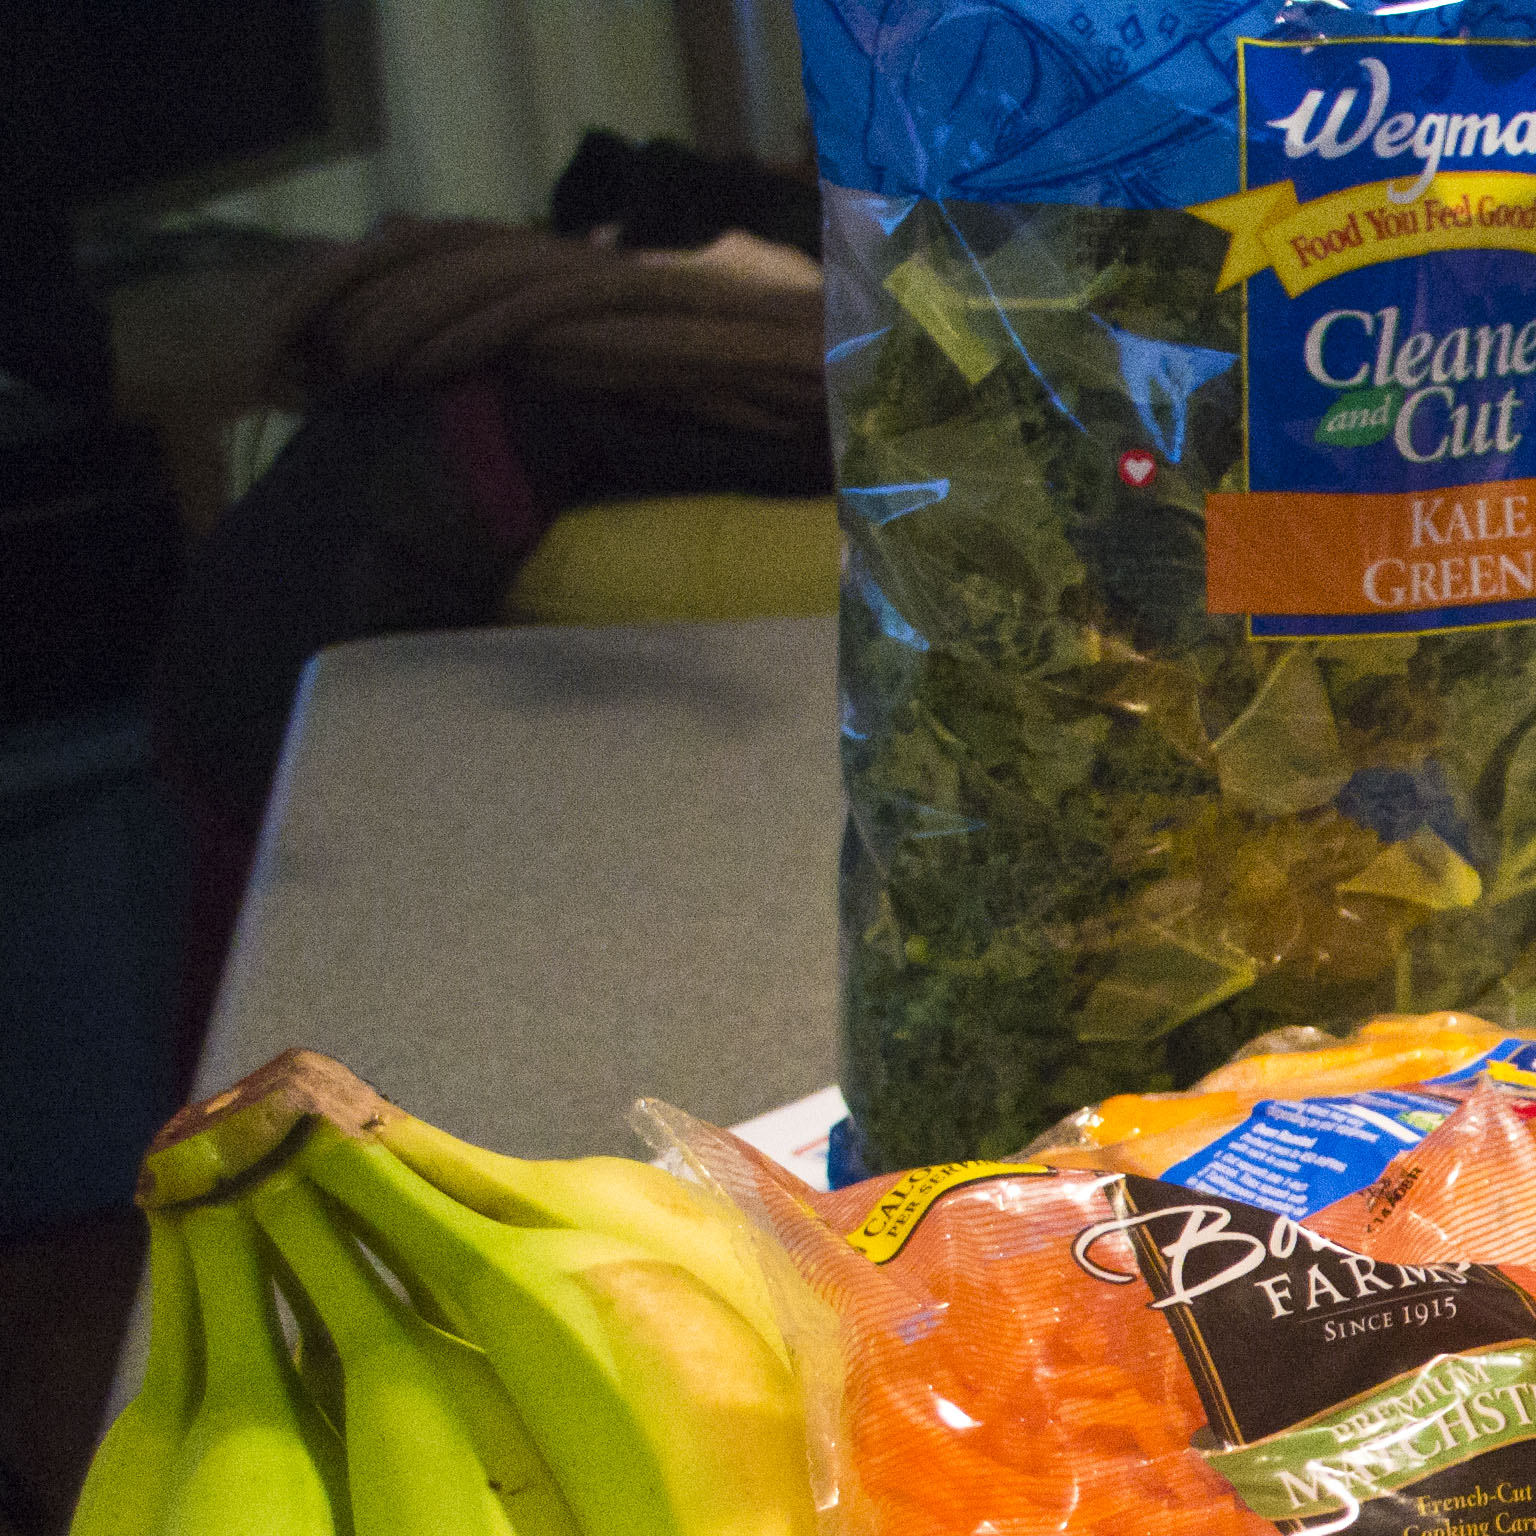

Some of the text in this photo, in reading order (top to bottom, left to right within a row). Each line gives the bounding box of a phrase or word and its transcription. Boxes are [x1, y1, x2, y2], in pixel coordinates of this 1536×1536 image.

[1290, 212, 1364, 268] Food
[1364, 205, 1419, 241] You
[1424, 195, 1474, 231] Feel
[1326, 386, 1523, 463] and Cut
[1411, 495, 1533, 548] KALE
[887, 1201, 920, 1238] PER
[1254, 1254, 1471, 1319] FARMS
[1323, 1295, 1459, 1343] SINCE 1915
[1330, 1360, 1492, 1444] PREMIUM
[1416, 1481, 1534, 1518] French-Cut
